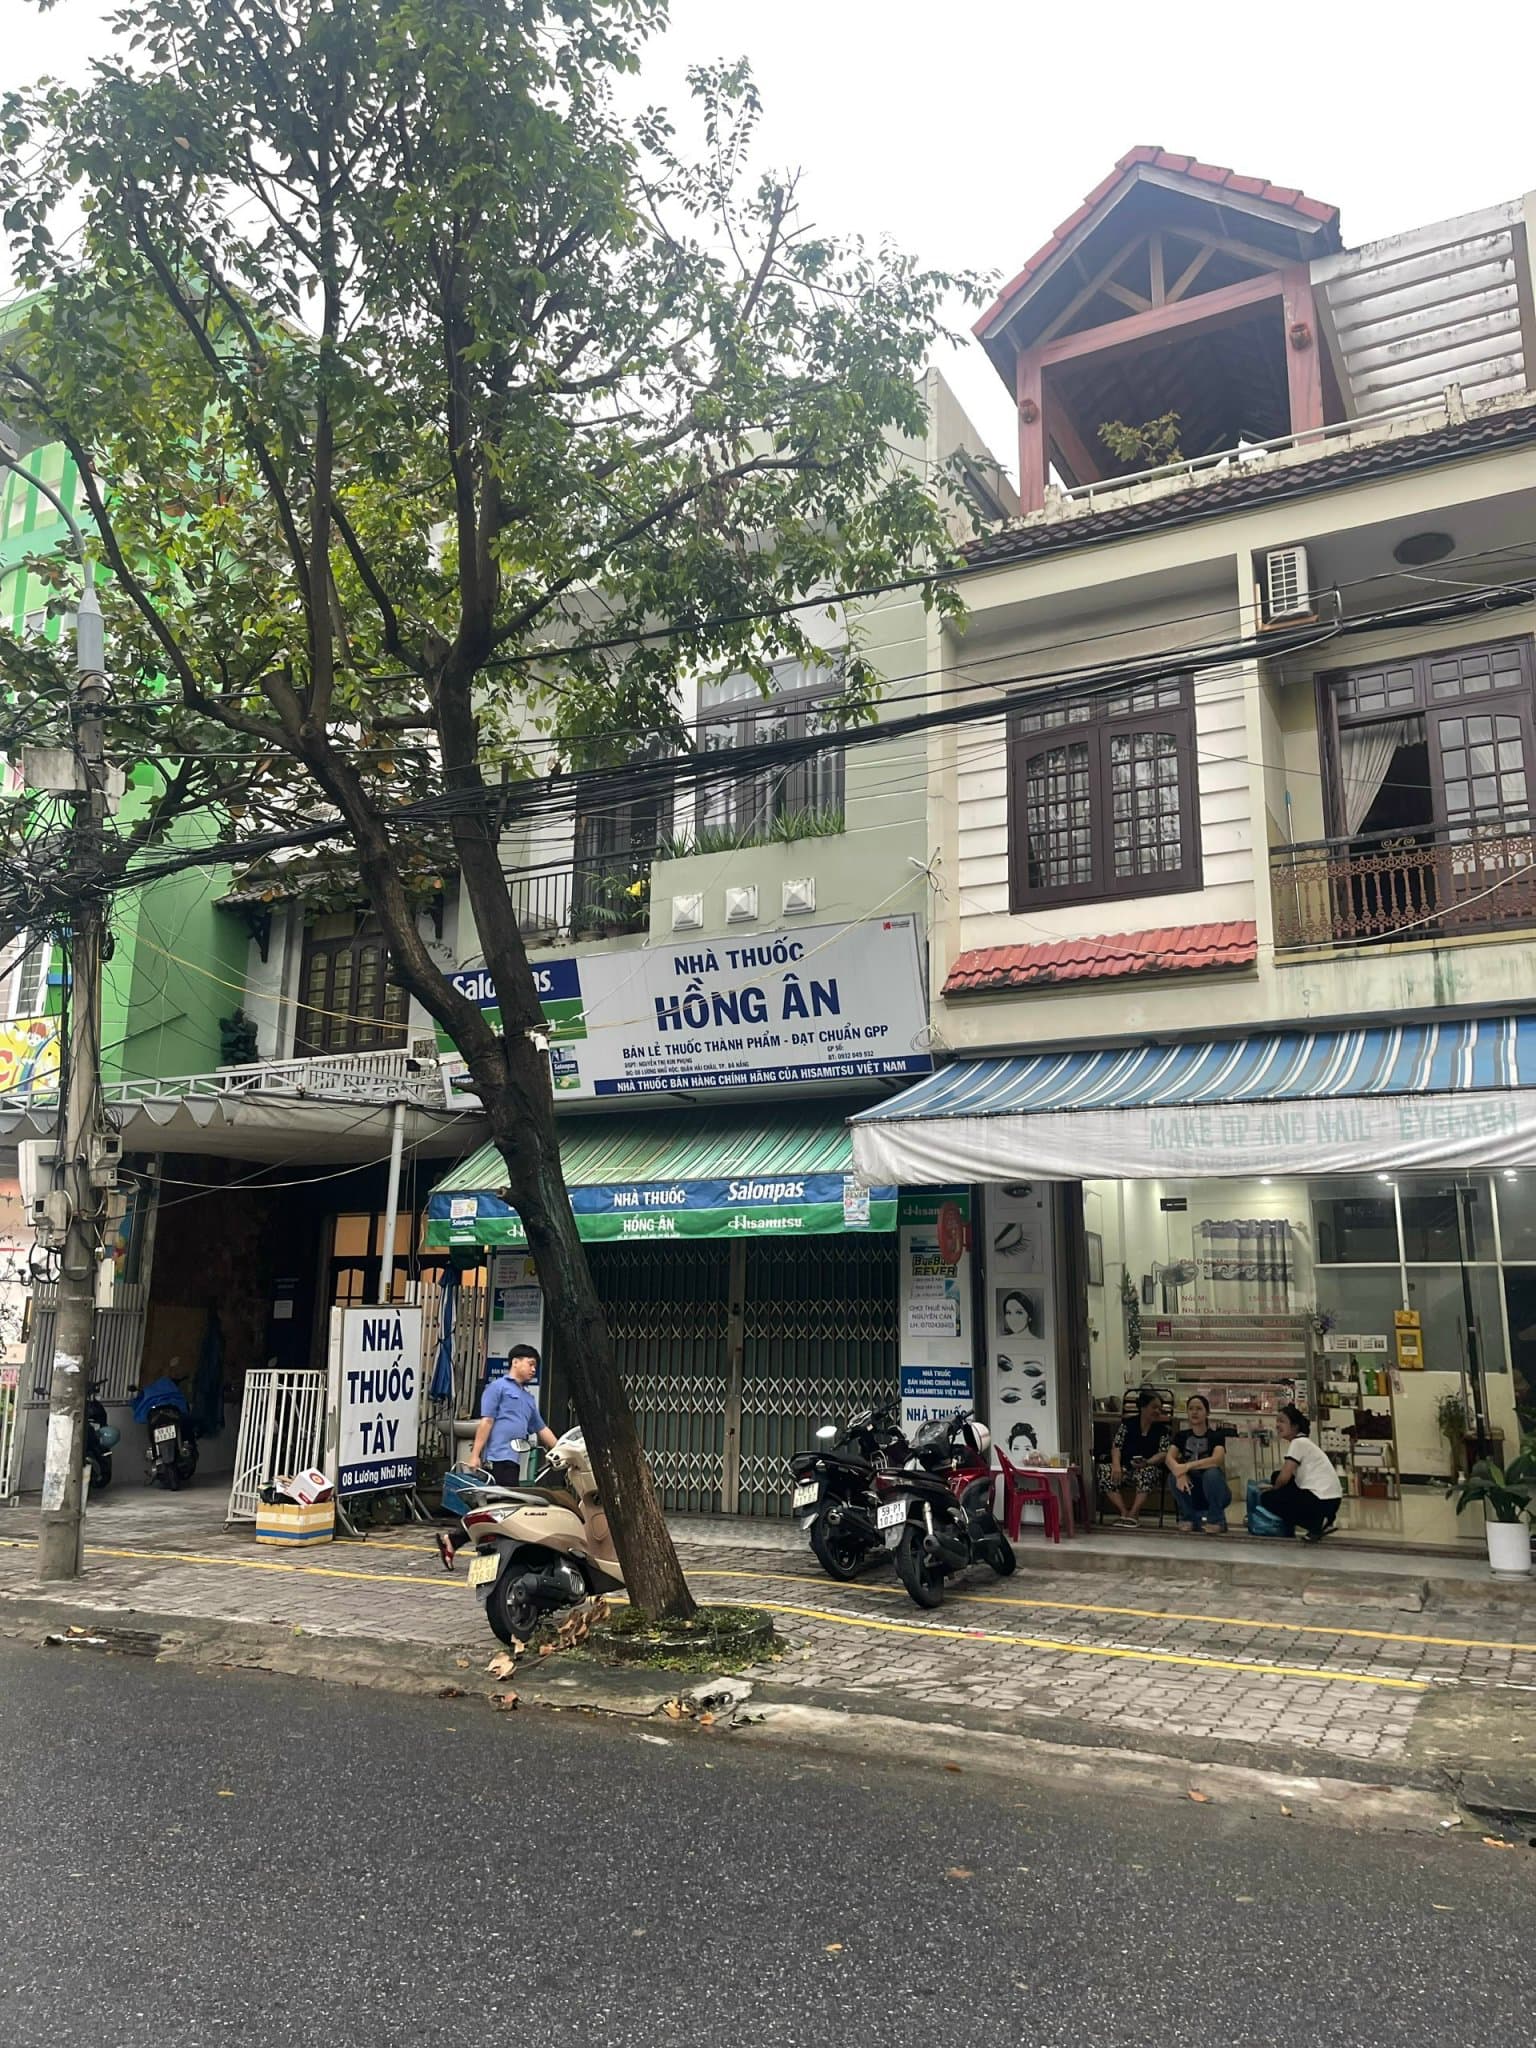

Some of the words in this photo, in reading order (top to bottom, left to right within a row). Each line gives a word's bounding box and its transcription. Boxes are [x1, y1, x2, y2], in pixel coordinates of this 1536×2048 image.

[674, 948, 719, 975] NHÀ
[726, 936, 804, 969] THUỐC
[452, 970, 551, 1001] Saloas
[655, 977, 768, 1031] HỒNG
[782, 973, 841, 1020] ÂN
[623, 1044, 645, 1059] BÁN
[649, 1041, 661, 1057] LẺ
[665, 1038, 702, 1055] THUỐC
[704, 1036, 743, 1052] THÀNH
[746, 1030, 780, 1049] PHẨM
[792, 1032, 815, 1047] ĐẠT
[819, 1022, 861, 1043] CHUẨN
[864, 1025, 888, 1038] GPP
[617, 1078, 636, 1092] NHÀ
[638, 1075, 668, 1090] THUỐC
[670, 1074, 689, 1089] BÁN
[691, 1073, 716, 1086] HÀNG
[718, 1071, 748, 1085] CHÍNH
[750, 1069, 776, 1083] HÃNG
[778, 1066, 799, 1081] CỦA
[801, 1064, 854, 1079] HISAMITSU
[857, 1061, 880, 1075] VIỆT
[883, 1059, 907, 1072] NAM
[1150, 1113, 1213, 1150] MAKE
[1259, 1110, 1305, 1145] AND
[1315, 1109, 1373, 1144] NAIL
[1401, 1102, 1518, 1141] EYELASH
[613, 1188, 639, 1207] NHÀ
[643, 1184, 686, 1205] THUỐC
[727, 1181, 805, 1203] Salonpas
[658, 1214, 675, 1231] ÂN
[727, 1214, 804, 1230] Hisamitsu
[362, 1310, 403, 1351] NHÀ
[347, 1354, 414, 1404] THUỐC
[906, 1405, 928, 1421] NHÀ
[360, 1412, 399, 1455] TÂY
[342, 1471, 353, 1487] 08
[354, 1467, 379, 1484] Lương
[380, 1464, 396, 1480] Nhữ
[397, 1464, 413, 1481] Hộc
